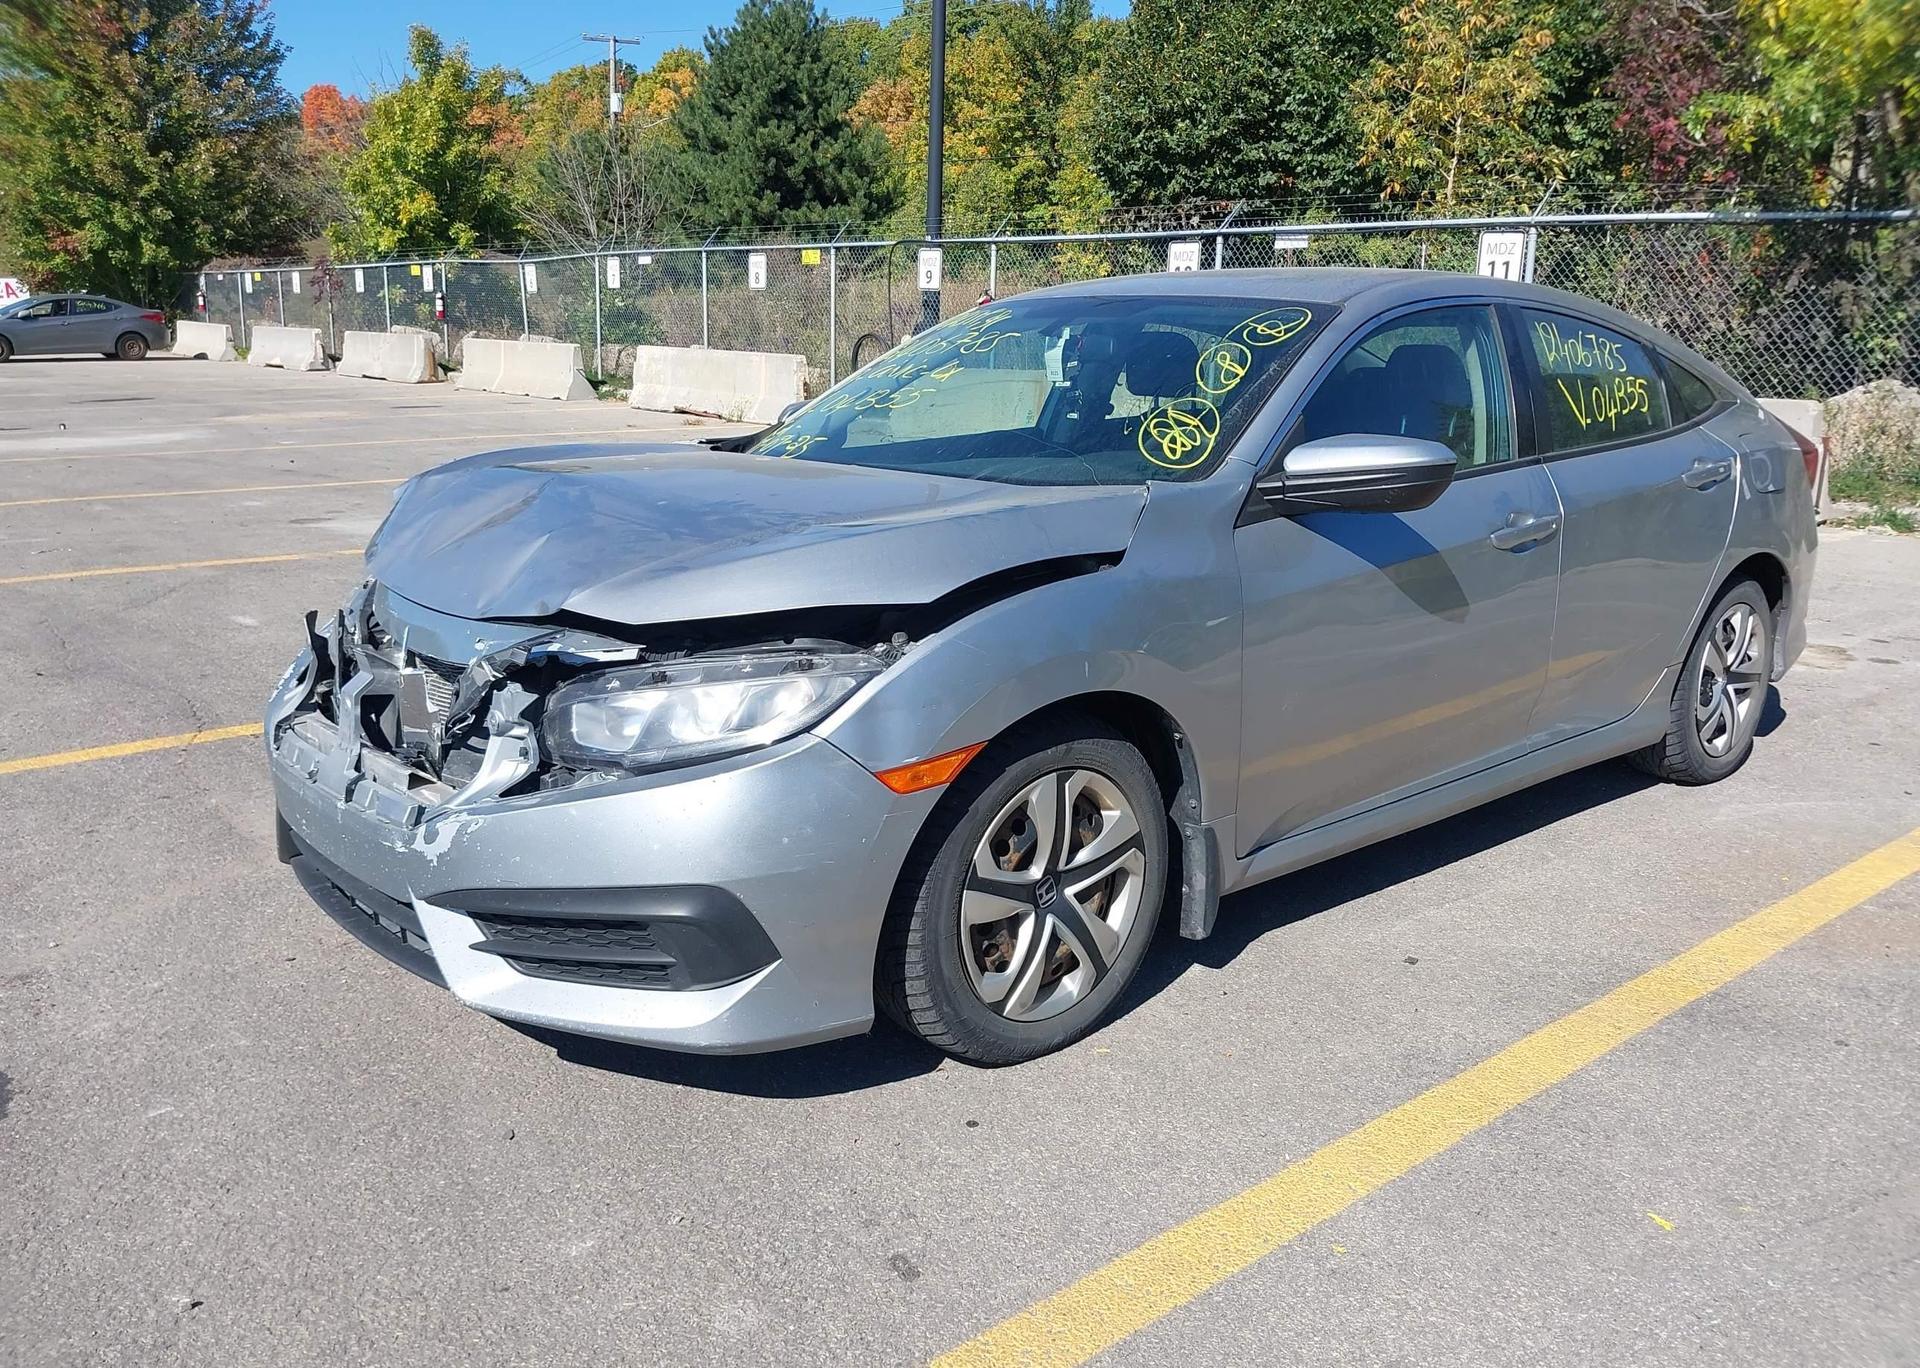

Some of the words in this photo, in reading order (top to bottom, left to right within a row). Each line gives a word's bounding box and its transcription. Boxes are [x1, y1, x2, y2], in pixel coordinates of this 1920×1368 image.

[1487, 242, 1516, 255] MDZ
[922, 257, 938, 267] MDZ
[1173, 250, 1195, 262] MDZ
[1487, 260, 1510, 279] 11
[754, 272, 761, 284] 8
[925, 270, 933, 284] 9
